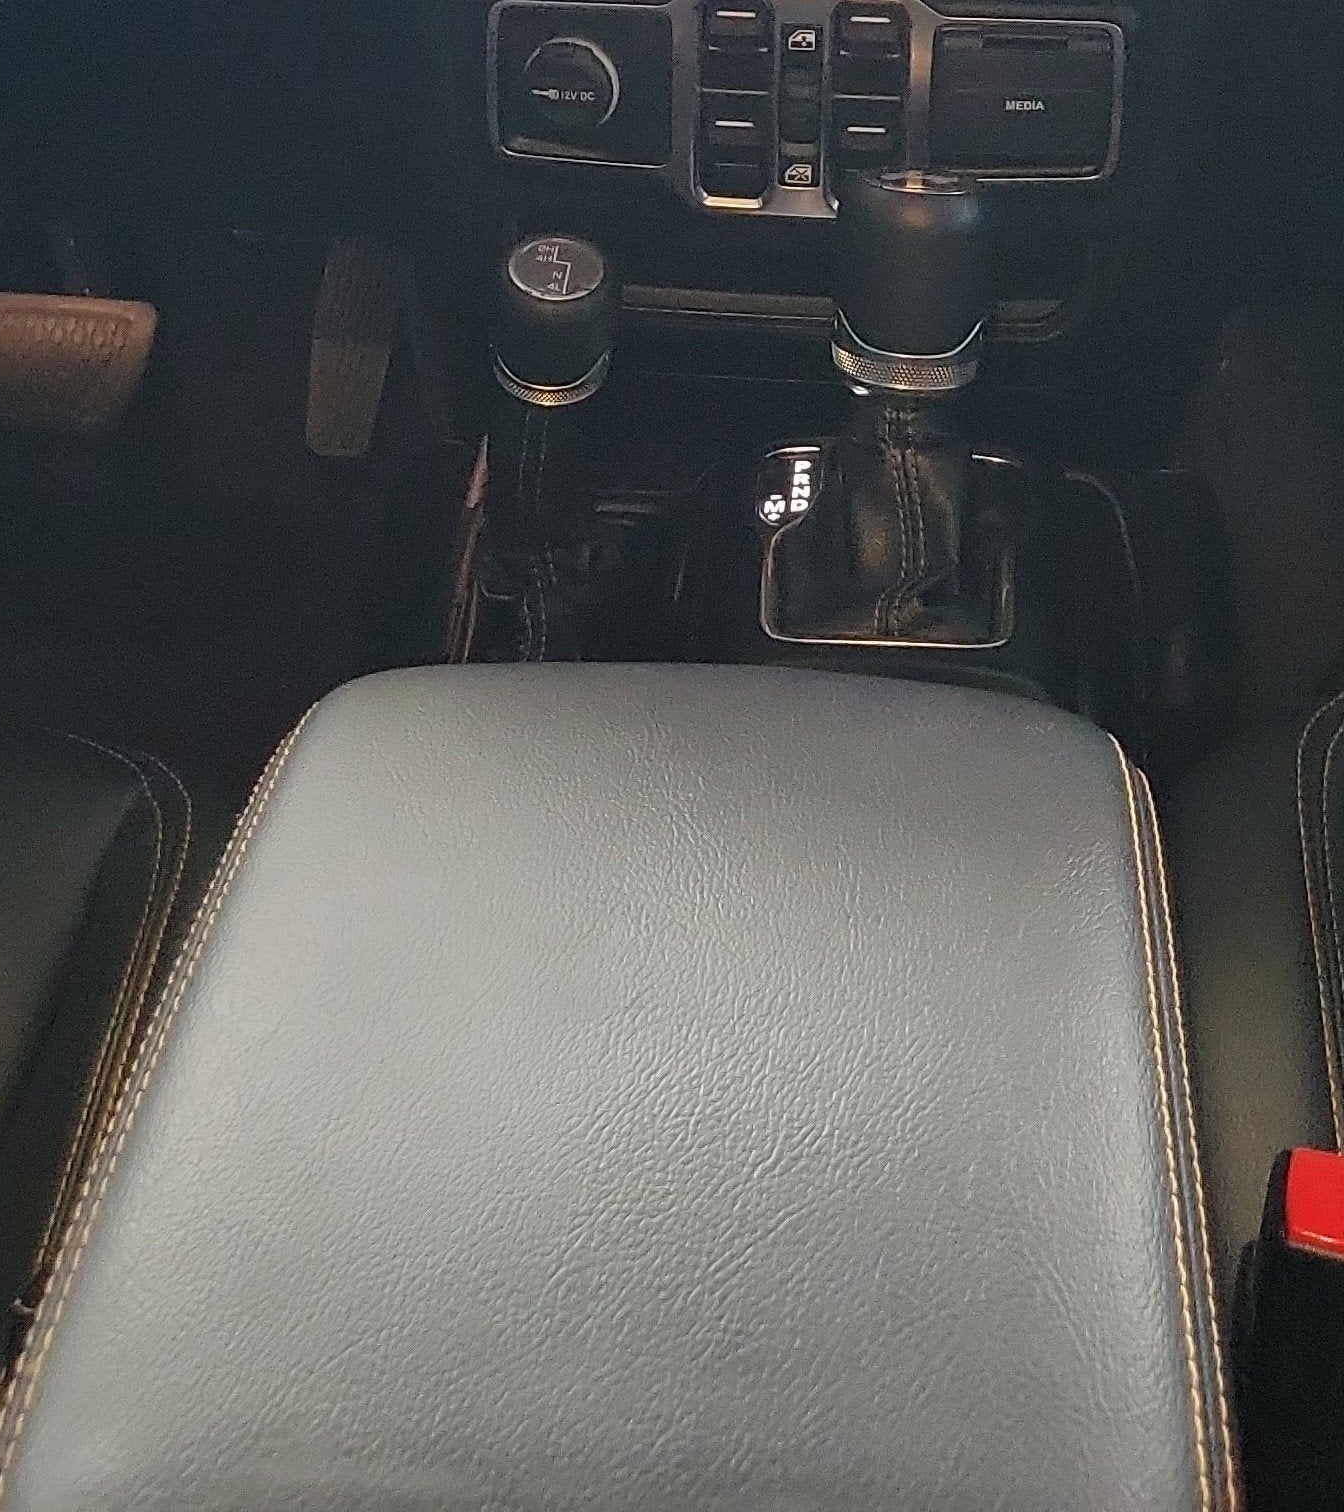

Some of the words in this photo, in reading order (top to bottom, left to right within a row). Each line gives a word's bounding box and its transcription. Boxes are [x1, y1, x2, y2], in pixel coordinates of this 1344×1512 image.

[560, 91, 578, 100] 12V
[580, 92, 595, 101] DC
[1004, 99, 1045, 111] MEDIA
